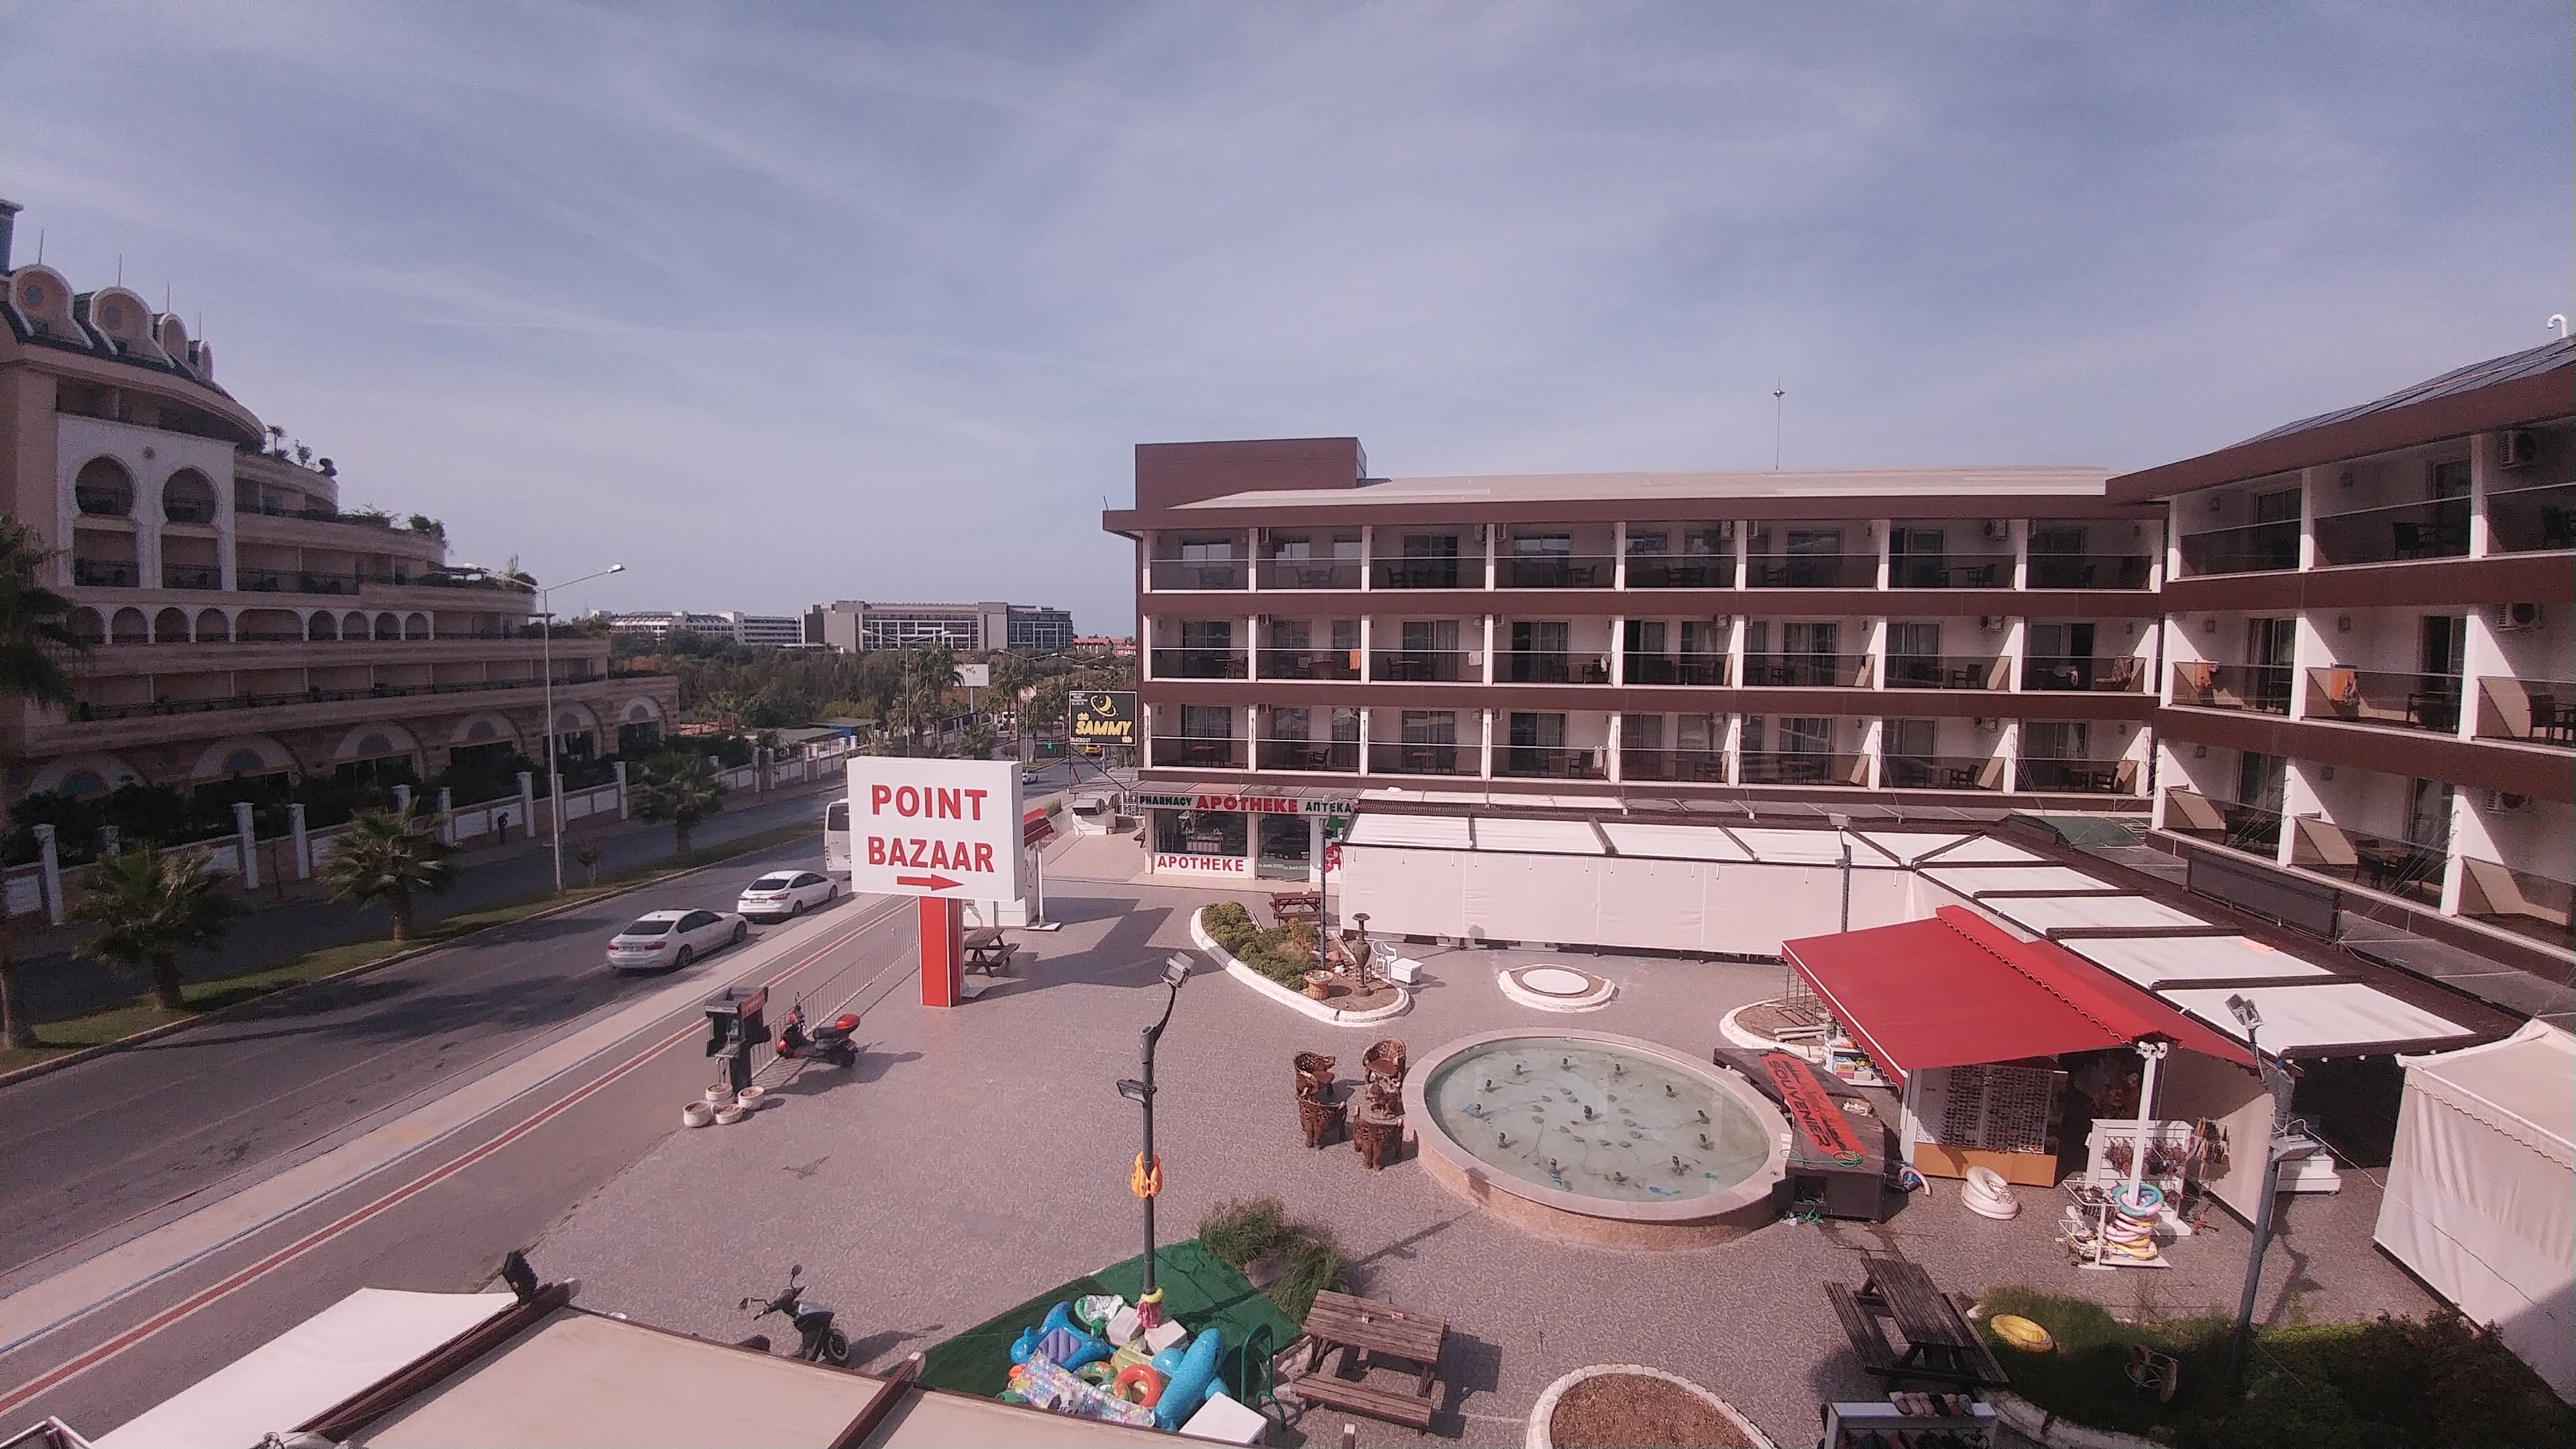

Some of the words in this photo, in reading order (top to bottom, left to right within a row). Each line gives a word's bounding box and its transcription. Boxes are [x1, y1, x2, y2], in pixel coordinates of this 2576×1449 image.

[1075, 720, 1132, 736] SAMMY
[872, 784, 987, 821] POINT
[1140, 796, 1192, 806] PHARMACY
[1196, 796, 1298, 813] APOTHEKE
[1305, 801, 1352, 813] АПТЕКА
[868, 836, 995, 873] BAZAAR
[1157, 855, 1244, 872] APOTHEKE
[1768, 1060, 1831, 1147] SOUVENIER
